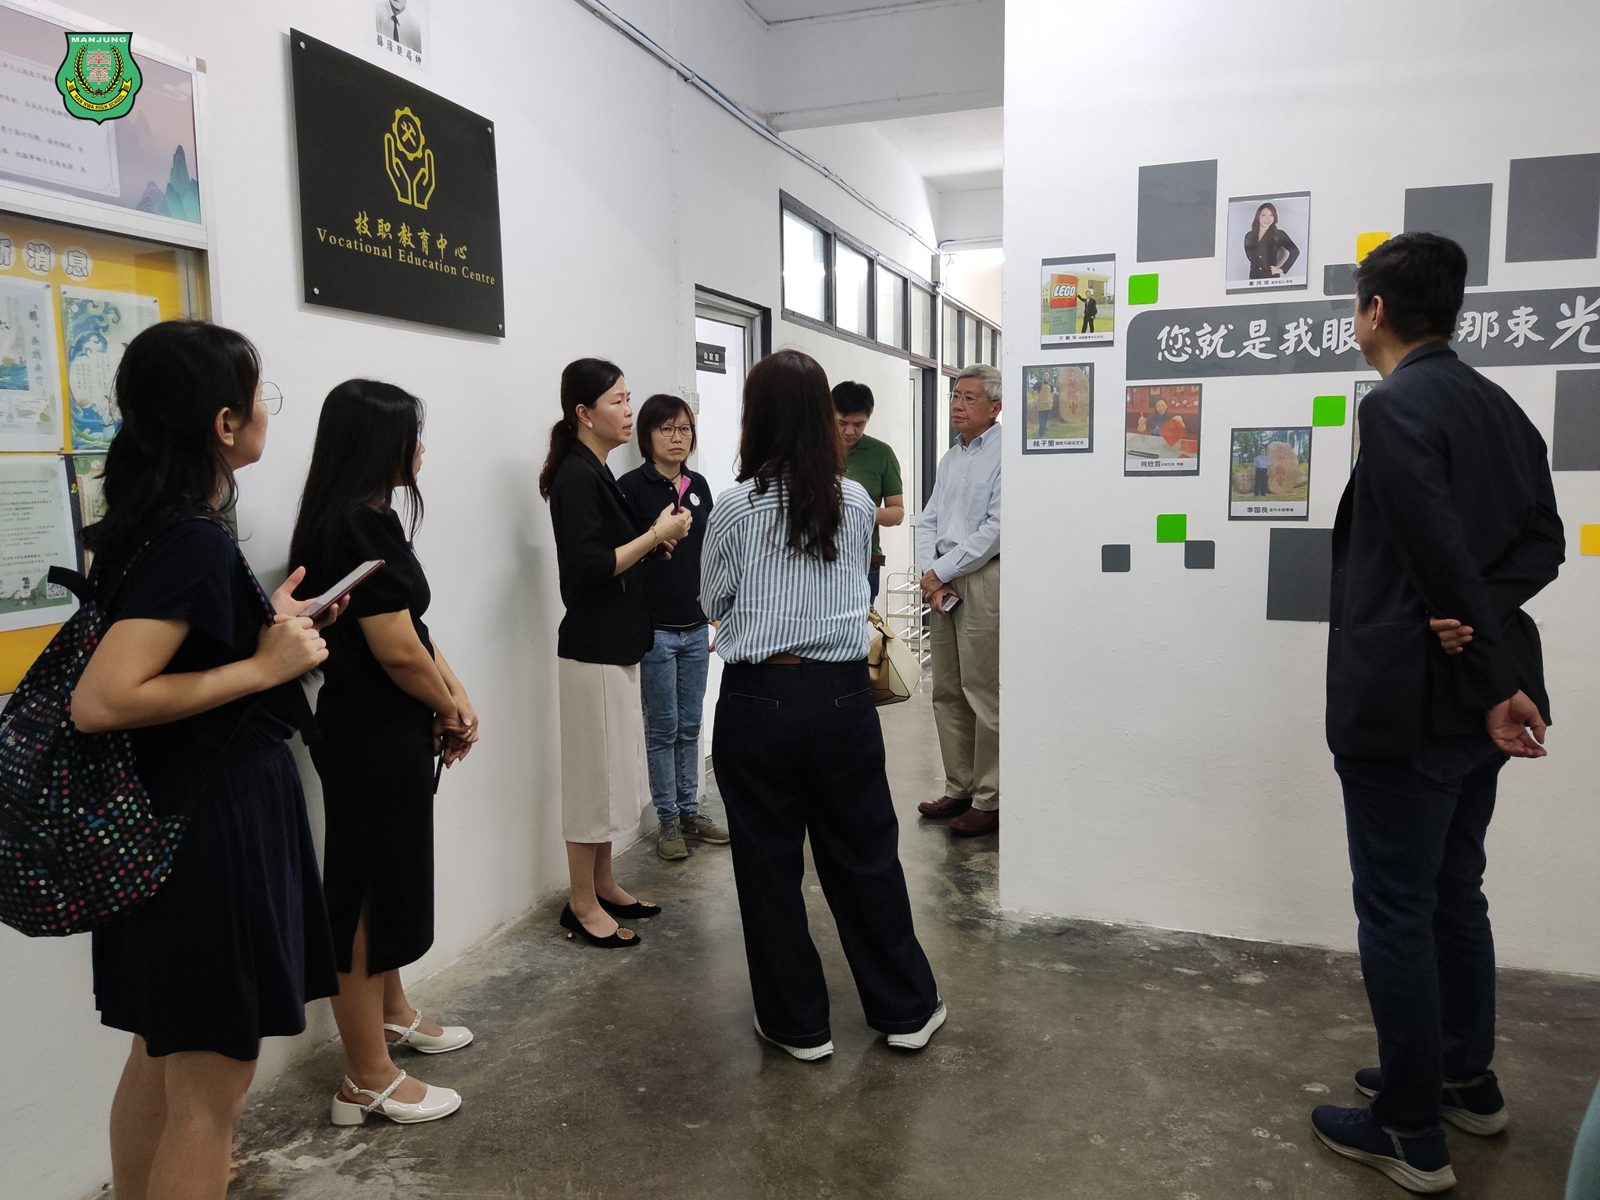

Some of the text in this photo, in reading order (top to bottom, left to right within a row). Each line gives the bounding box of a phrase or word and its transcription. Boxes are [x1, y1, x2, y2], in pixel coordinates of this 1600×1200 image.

[316, 227, 496, 285] Vocational Education Centre
[354, 211, 468, 260] 技职教育中心
[1054, 285, 1076, 297] LEGO
